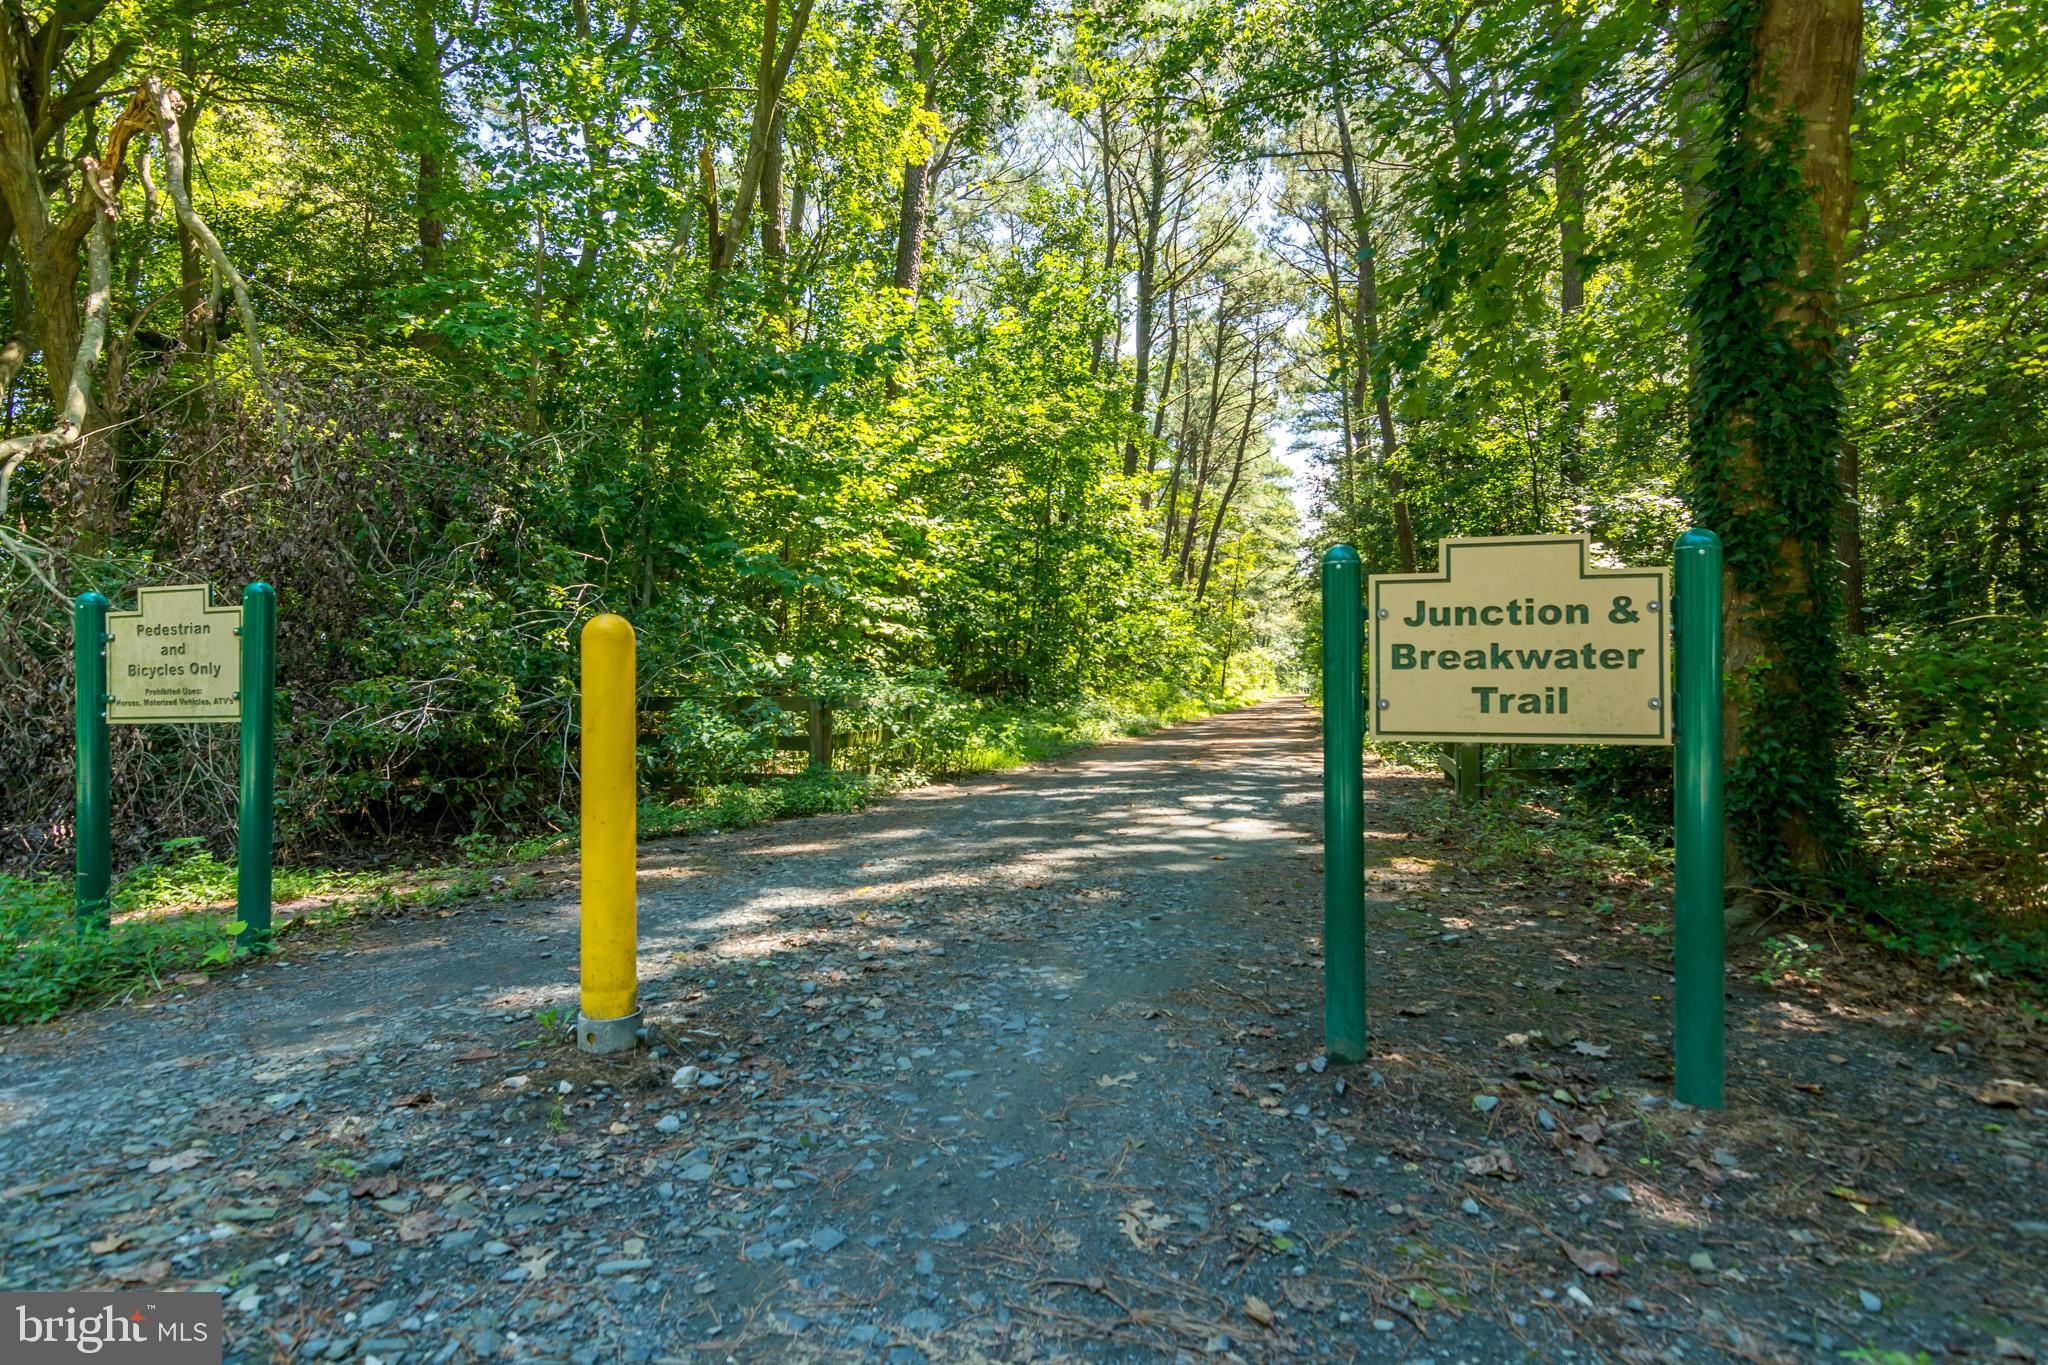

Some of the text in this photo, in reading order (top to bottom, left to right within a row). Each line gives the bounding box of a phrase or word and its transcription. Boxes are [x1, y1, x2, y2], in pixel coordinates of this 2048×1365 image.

[1403, 595, 1641, 627] Junction &
[136, 622, 211, 637] Pedestrian
[160, 643, 186, 656] and
[1391, 643, 1645, 670] Breakwater
[127, 662, 222, 680] Bicycles Only
[145, 687, 203, 696] Prohibited Uses:
[143, 698, 178, 707] Motorized
[1471, 686, 1569, 714] Trail
